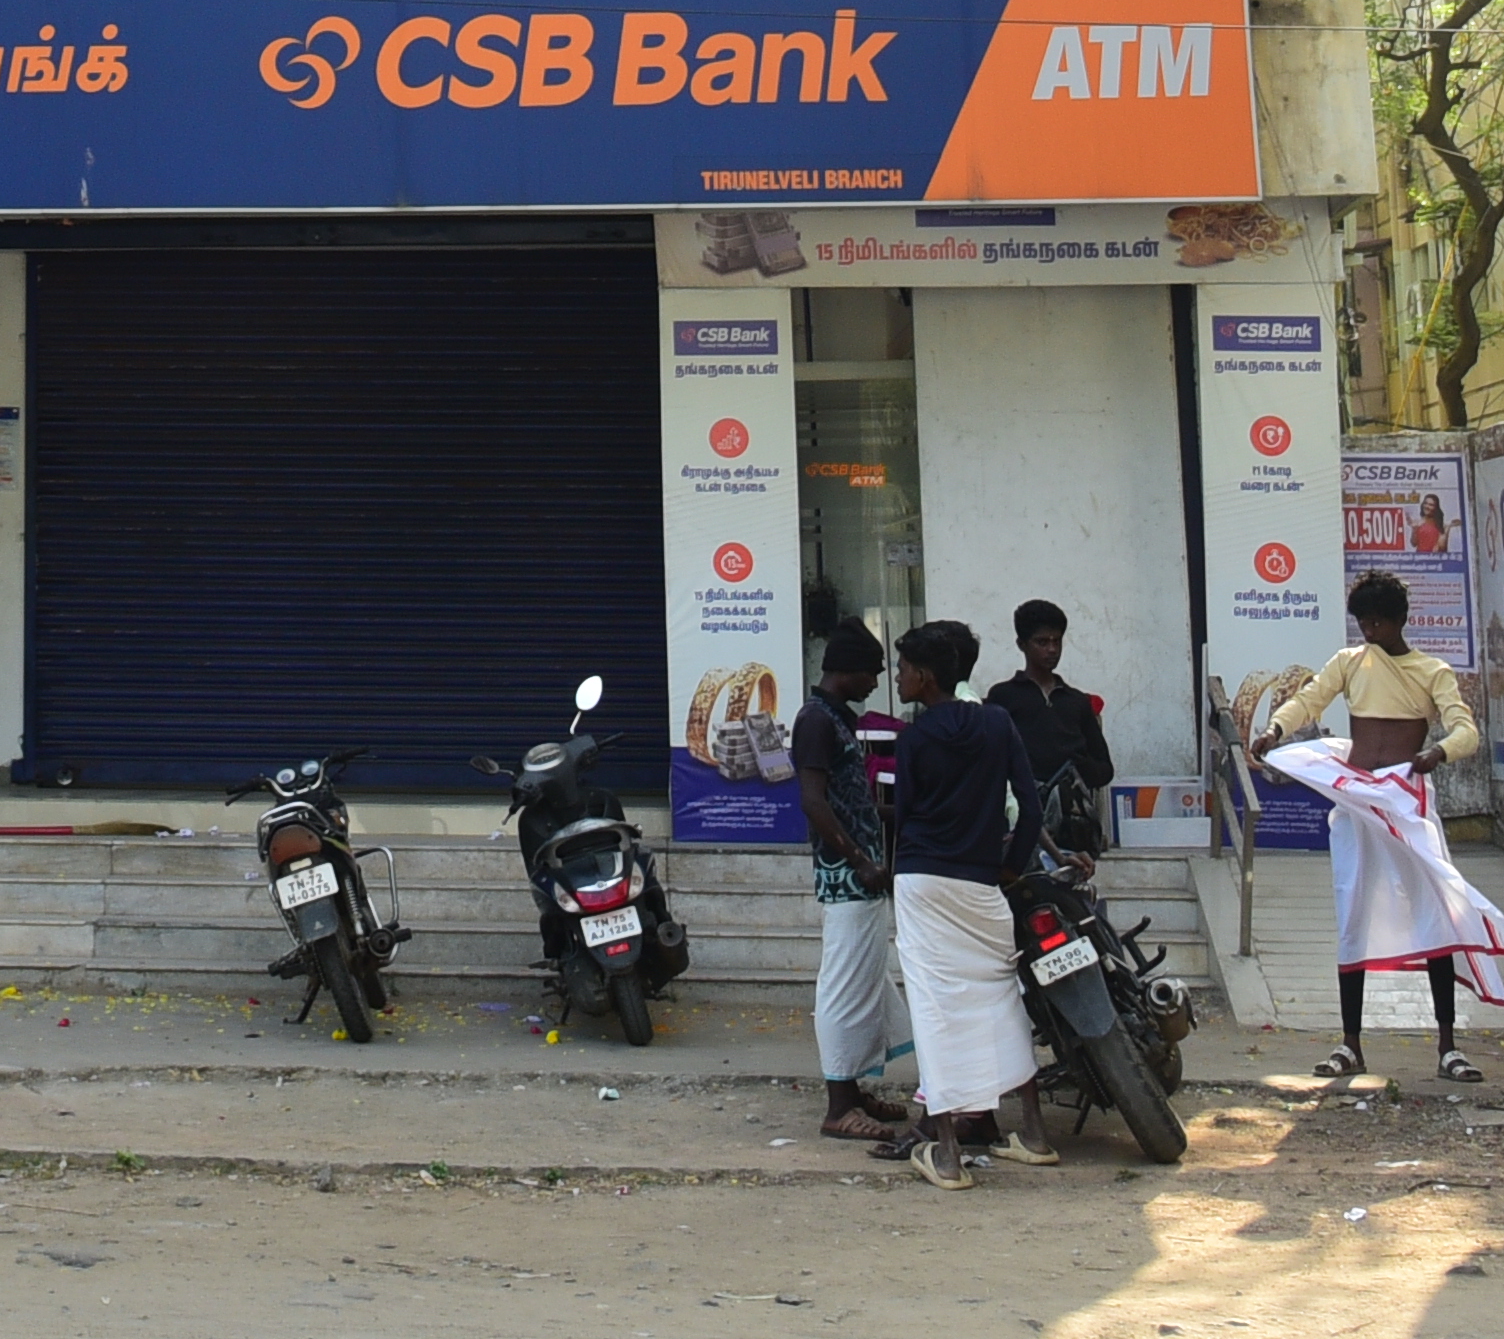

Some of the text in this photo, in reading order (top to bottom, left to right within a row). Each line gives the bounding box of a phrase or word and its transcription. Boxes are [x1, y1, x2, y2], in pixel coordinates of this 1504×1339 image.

[374, 9, 1214, 110] CSB Bank ATM
[700, 168, 903, 192] TIRUNELVELI BRANCH
[815, 235, 1160, 265] 15 நிமிடங்களில் தங்கநகை கடன்
[696, 326, 770, 342] CSB Bank
[1236, 322, 1313, 338] CSB Bank
[820, 463, 886, 476] CSB Bank
[1354, 464, 1441, 481] CSB Bank
[851, 475, 885, 486] ATM
[593, 913, 626, 928] TN 75
